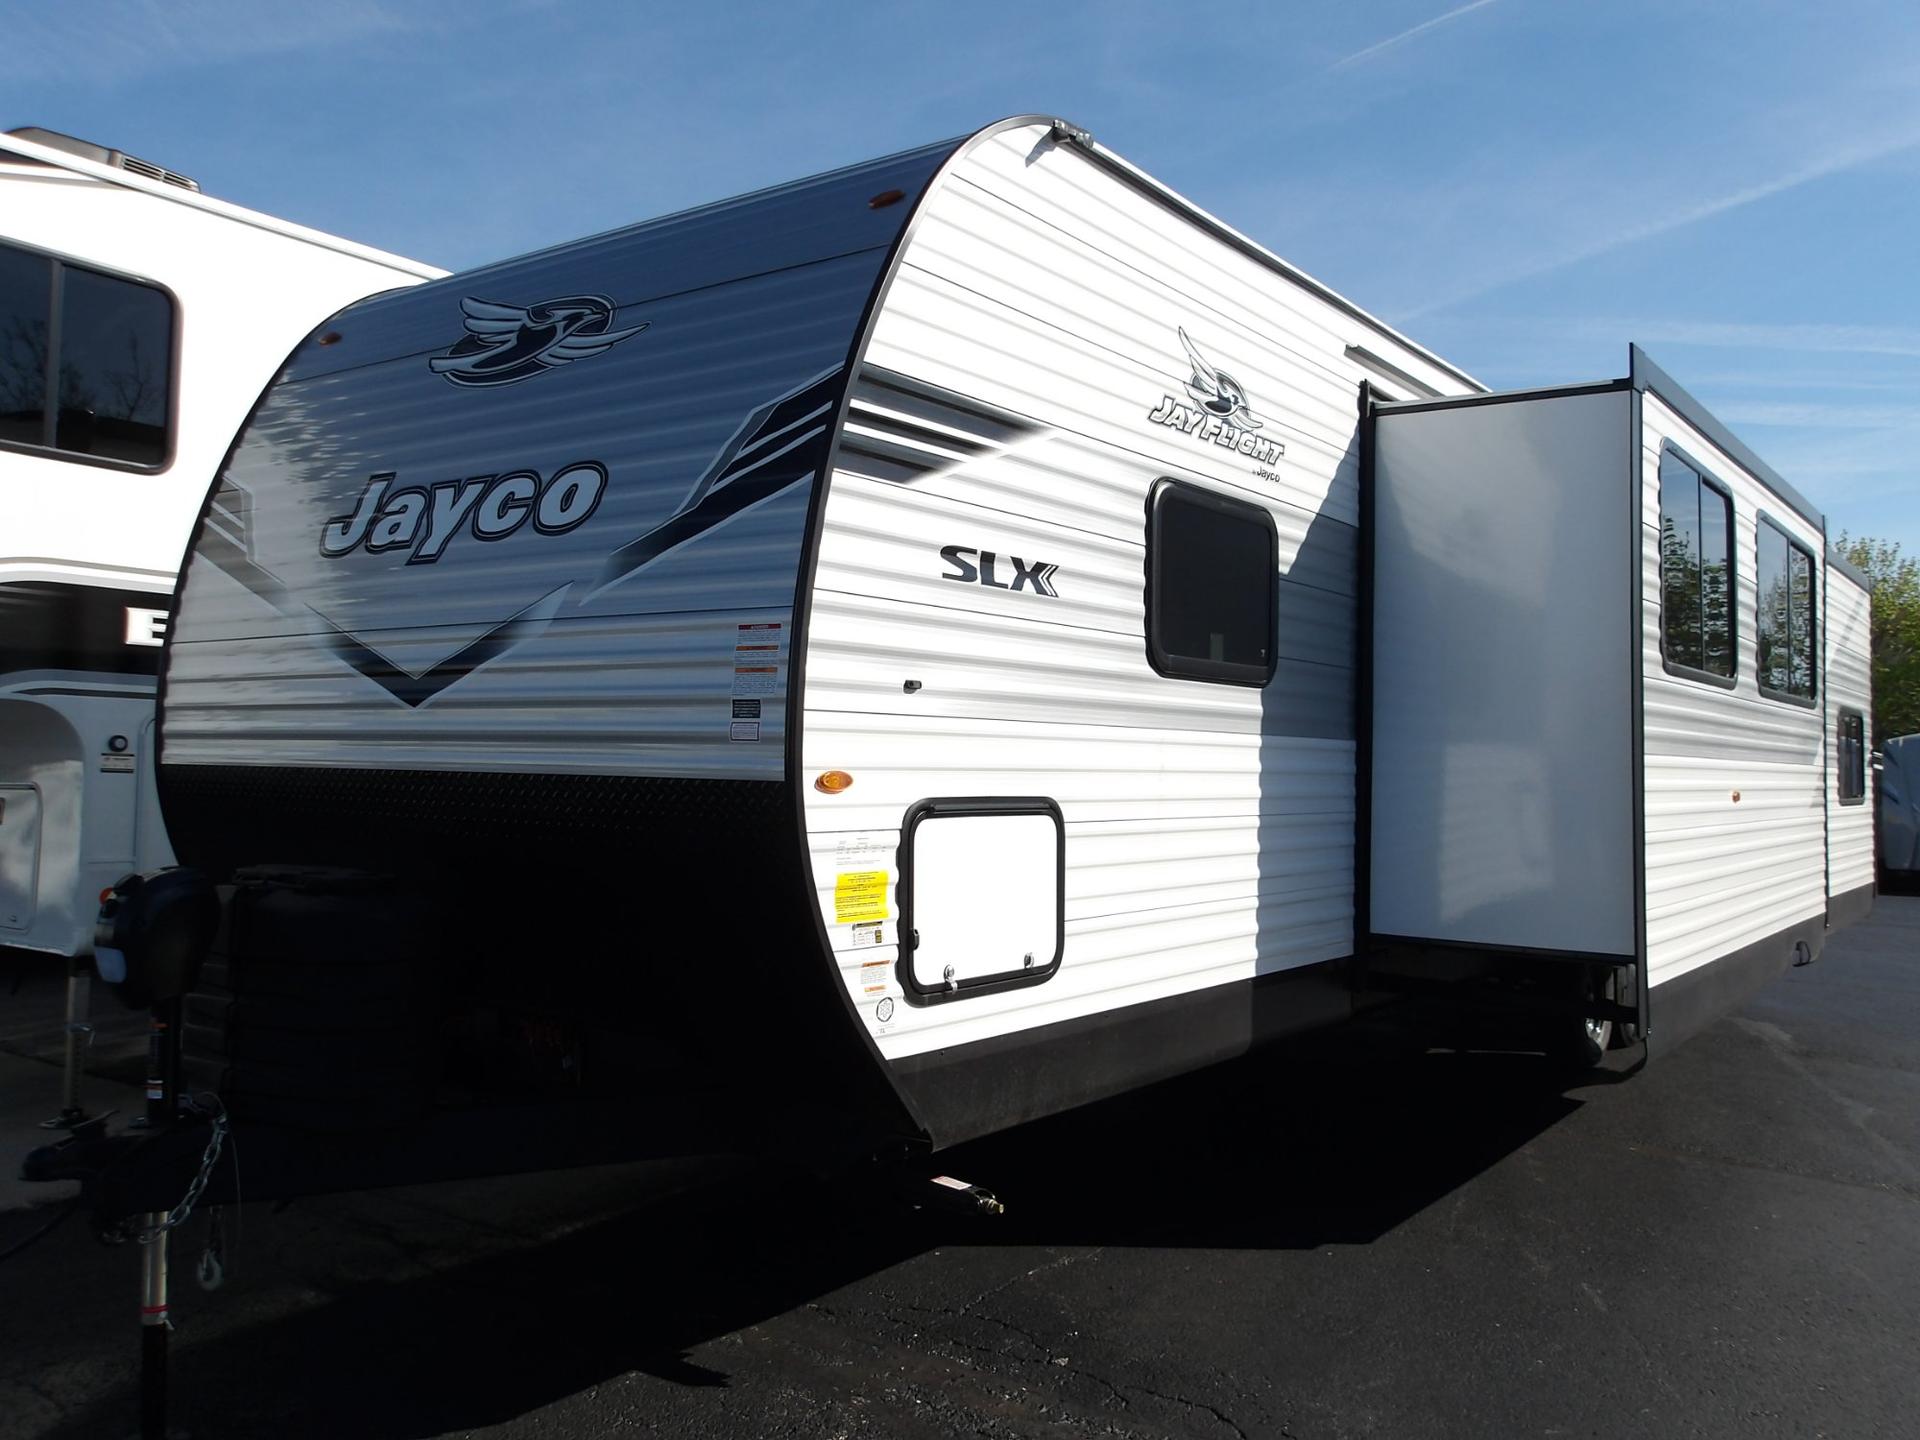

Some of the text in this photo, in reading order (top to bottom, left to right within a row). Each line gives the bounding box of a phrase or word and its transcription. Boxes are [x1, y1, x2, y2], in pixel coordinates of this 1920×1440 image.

[1148, 395, 1285, 465] JAY FLIGHT
[1257, 466, 1280, 483] Jayco
[320, 460, 608, 566] Jayco
[940, 545, 1059, 598] SLX
